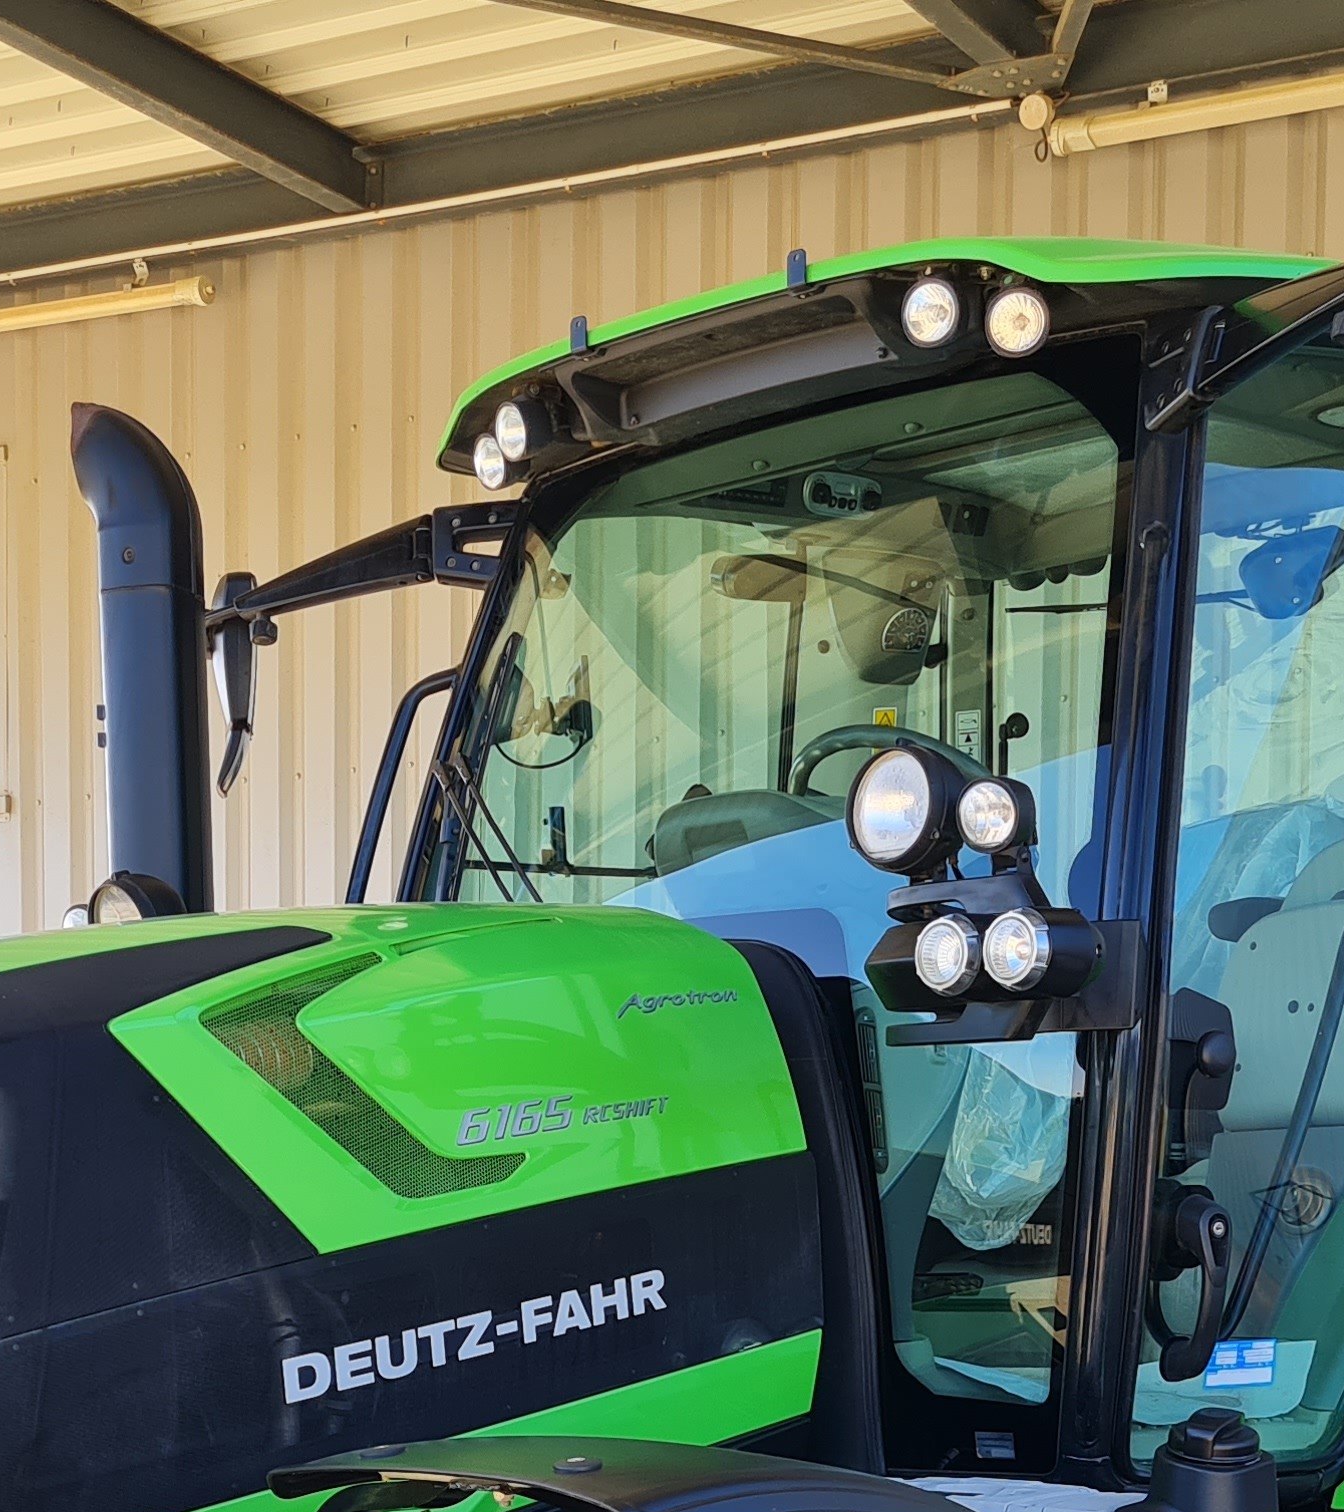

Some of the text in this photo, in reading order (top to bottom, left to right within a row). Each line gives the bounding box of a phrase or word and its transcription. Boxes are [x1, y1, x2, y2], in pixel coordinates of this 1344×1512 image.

[616, 989, 738, 1018] Agrotron
[456, 1095, 669, 1146] 6165 RCSHIFT
[281, 1270, 667, 1404] DEUTZ-FAHR
